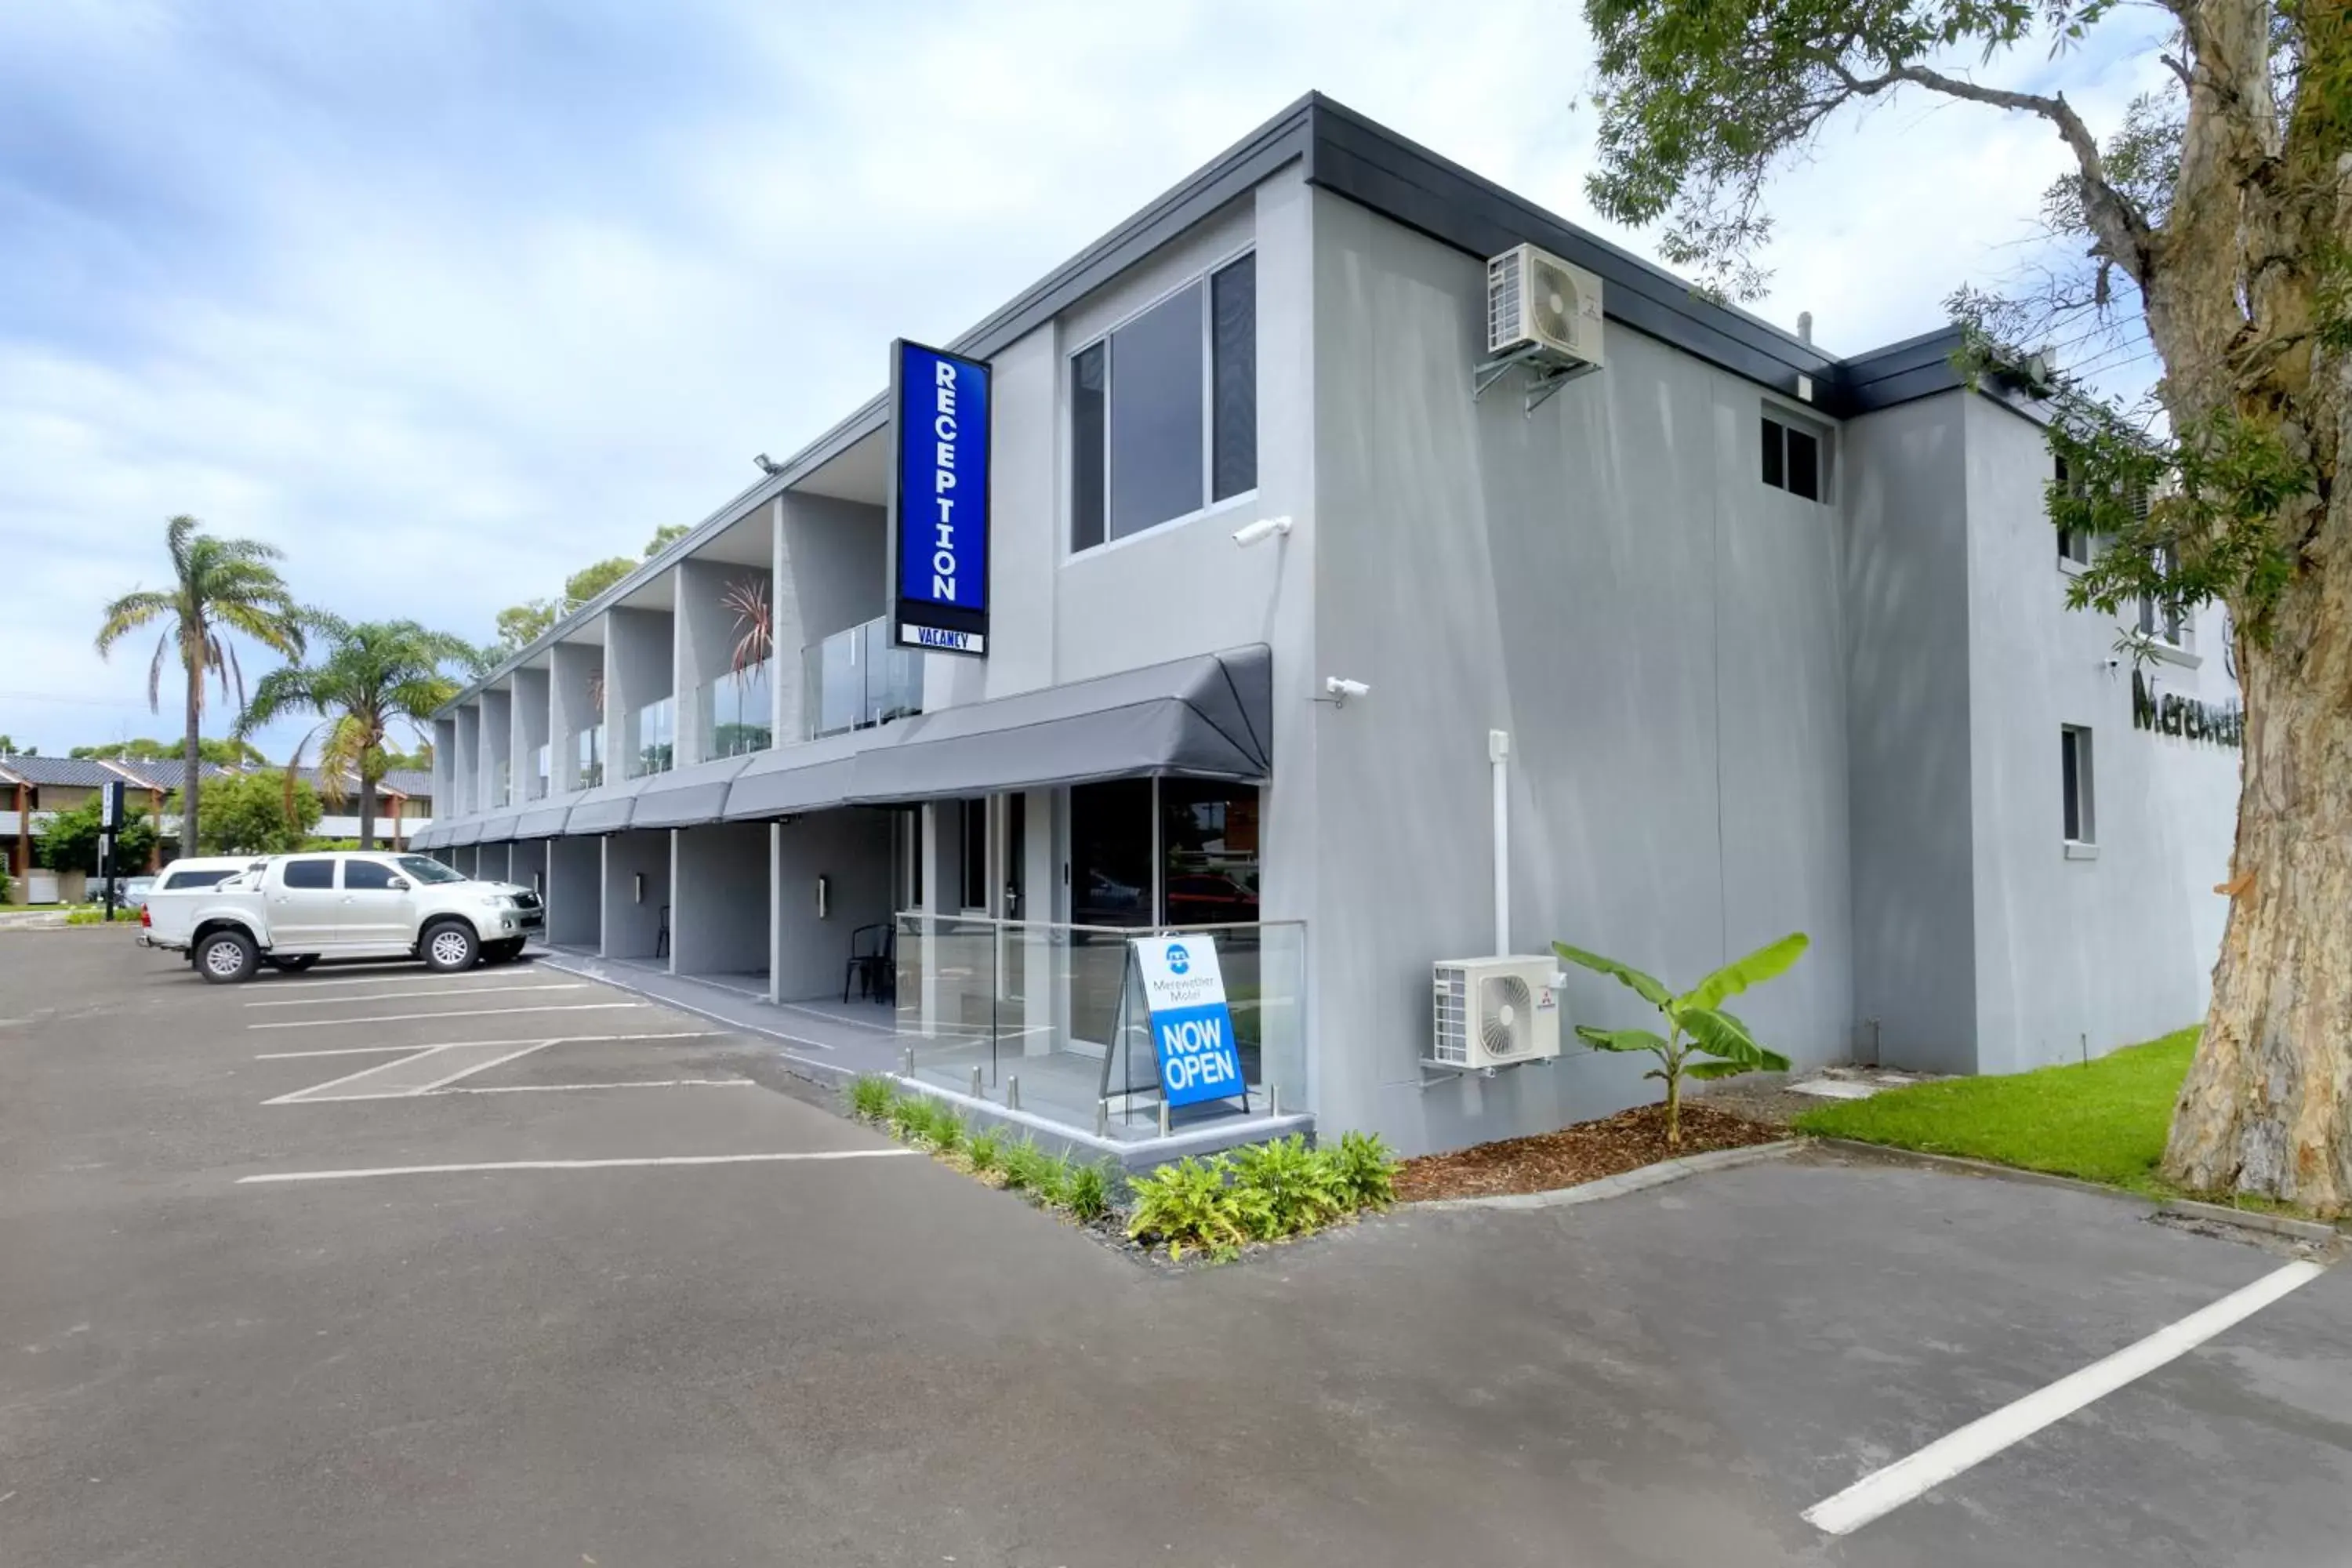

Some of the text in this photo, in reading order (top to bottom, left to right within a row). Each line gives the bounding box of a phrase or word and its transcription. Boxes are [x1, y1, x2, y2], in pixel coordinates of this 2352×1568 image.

[932, 361, 957, 601] RECEPTION
[918, 627, 968, 649] VACANCY
[1153, 977, 1214, 991] Merewether
[1170, 989, 1201, 1002] Motel
[1162, 1018, 1221, 1056] NOW
[1166, 1051, 1236, 1090] OPEN
